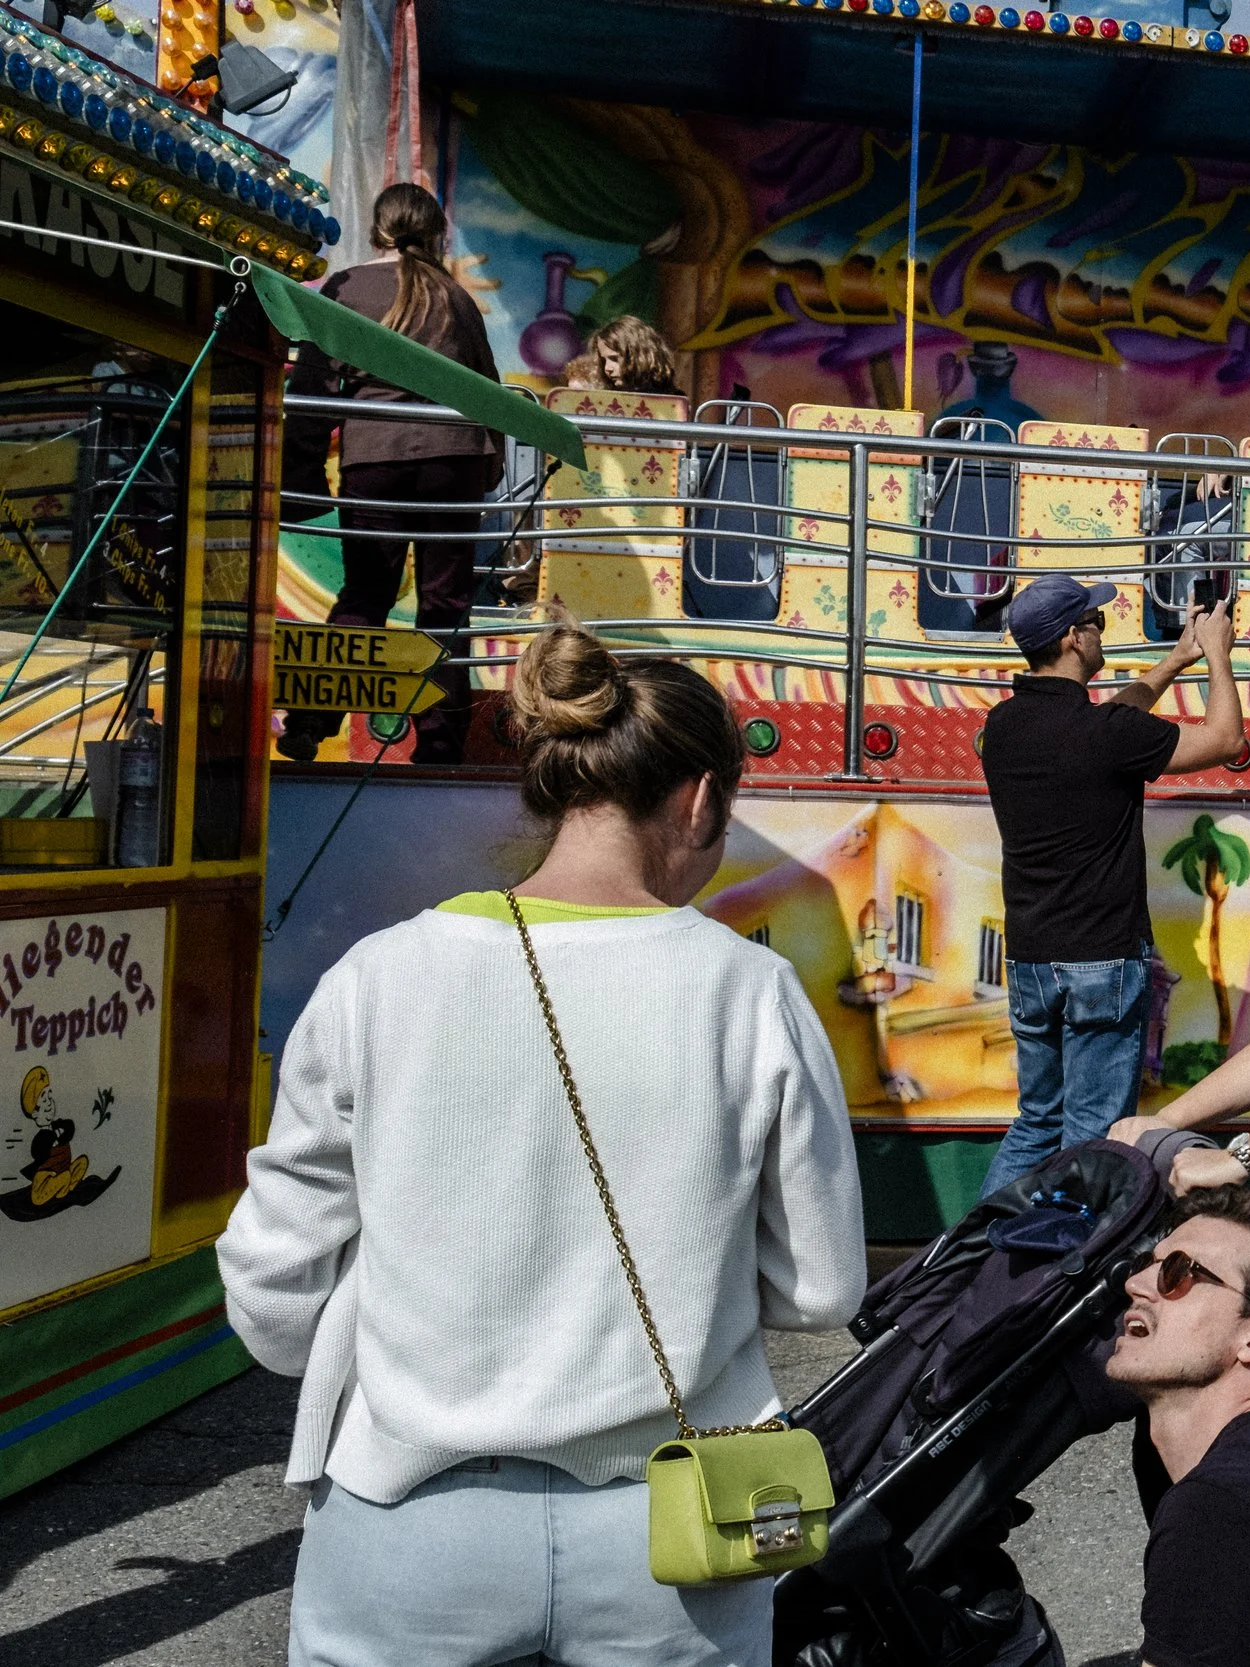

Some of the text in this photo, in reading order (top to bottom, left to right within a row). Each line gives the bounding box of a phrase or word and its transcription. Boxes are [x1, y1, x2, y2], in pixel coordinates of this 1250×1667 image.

[11, 990, 128, 1056] Teppich
[928, 1400, 993, 1458] ABC DESIGN
